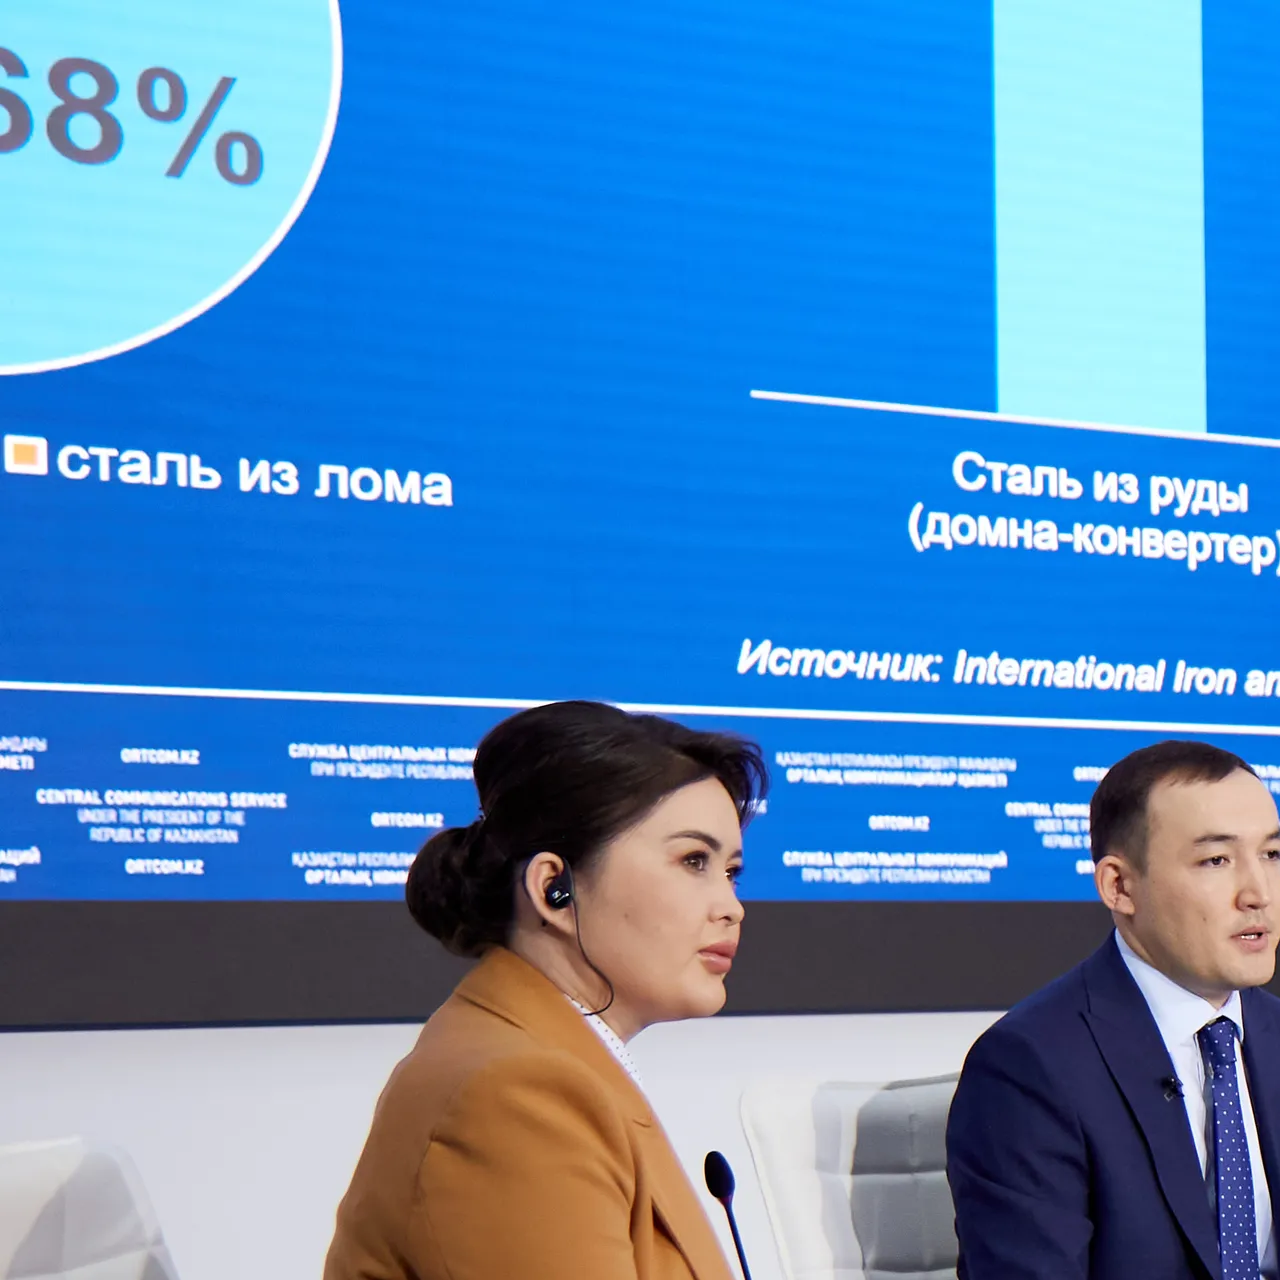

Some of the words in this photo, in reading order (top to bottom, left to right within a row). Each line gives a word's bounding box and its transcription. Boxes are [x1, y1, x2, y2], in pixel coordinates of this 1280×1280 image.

[56, 441, 223, 491] сталь
[239, 458, 299, 496] из
[314, 463, 454, 507] лома
[952, 451, 1082, 499] Сталь
[1093, 470, 1139, 503] из
[1149, 474, 1249, 518] руды
[736, 638, 942, 684] Источник:
[953, 648, 1166, 692] International
[1173, 658, 1238, 695] Iron
[36, 788, 103, 805] CENTRAL
